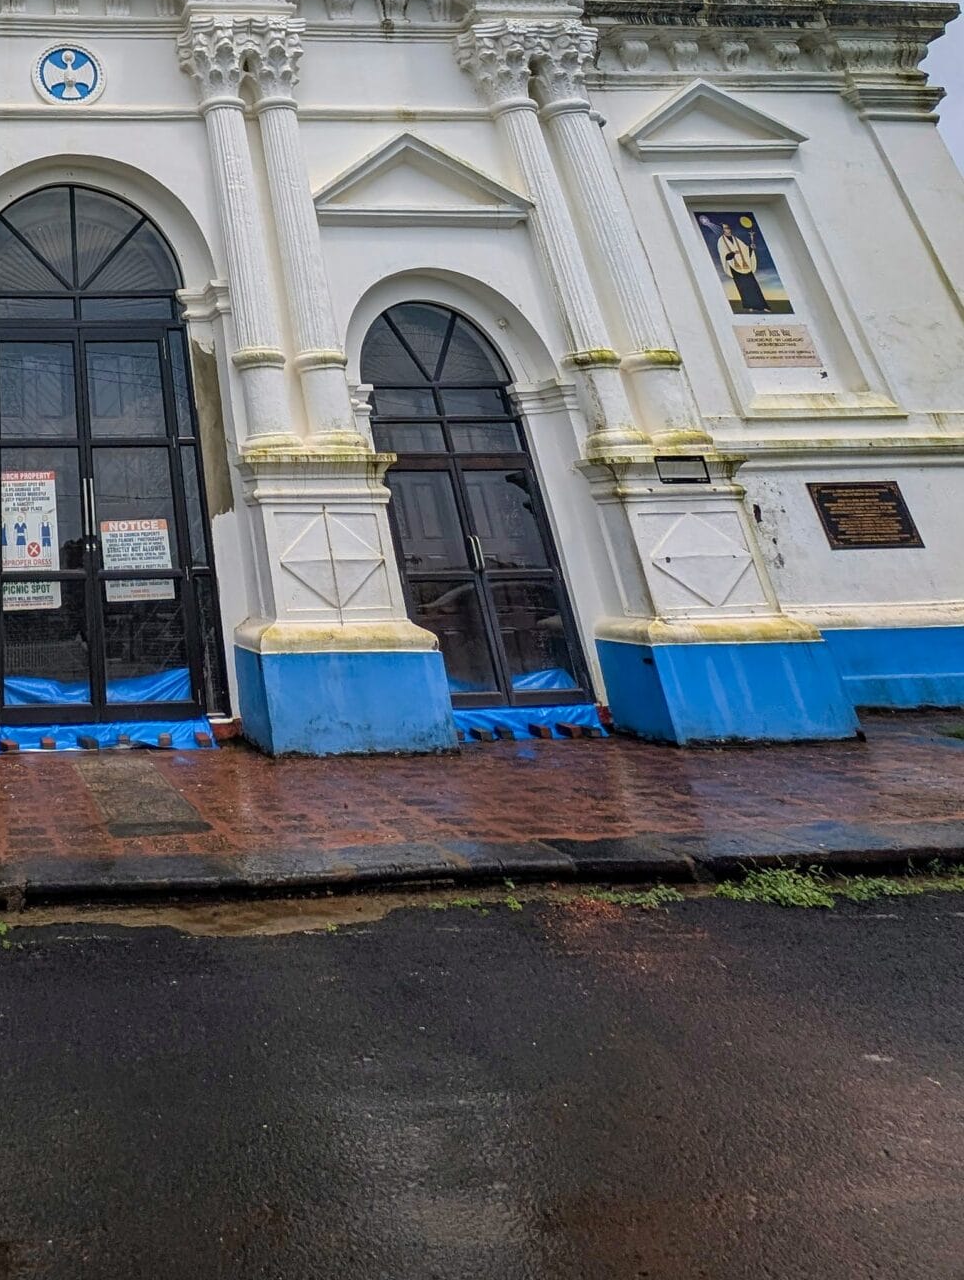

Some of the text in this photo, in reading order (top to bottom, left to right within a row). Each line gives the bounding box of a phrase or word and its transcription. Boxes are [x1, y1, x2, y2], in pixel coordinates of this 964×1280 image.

[20, 472, 50, 480] PROPERTY
[108, 520, 158, 531] NOTICE
[3, 585, 50, 594] PICNIC SPOT
